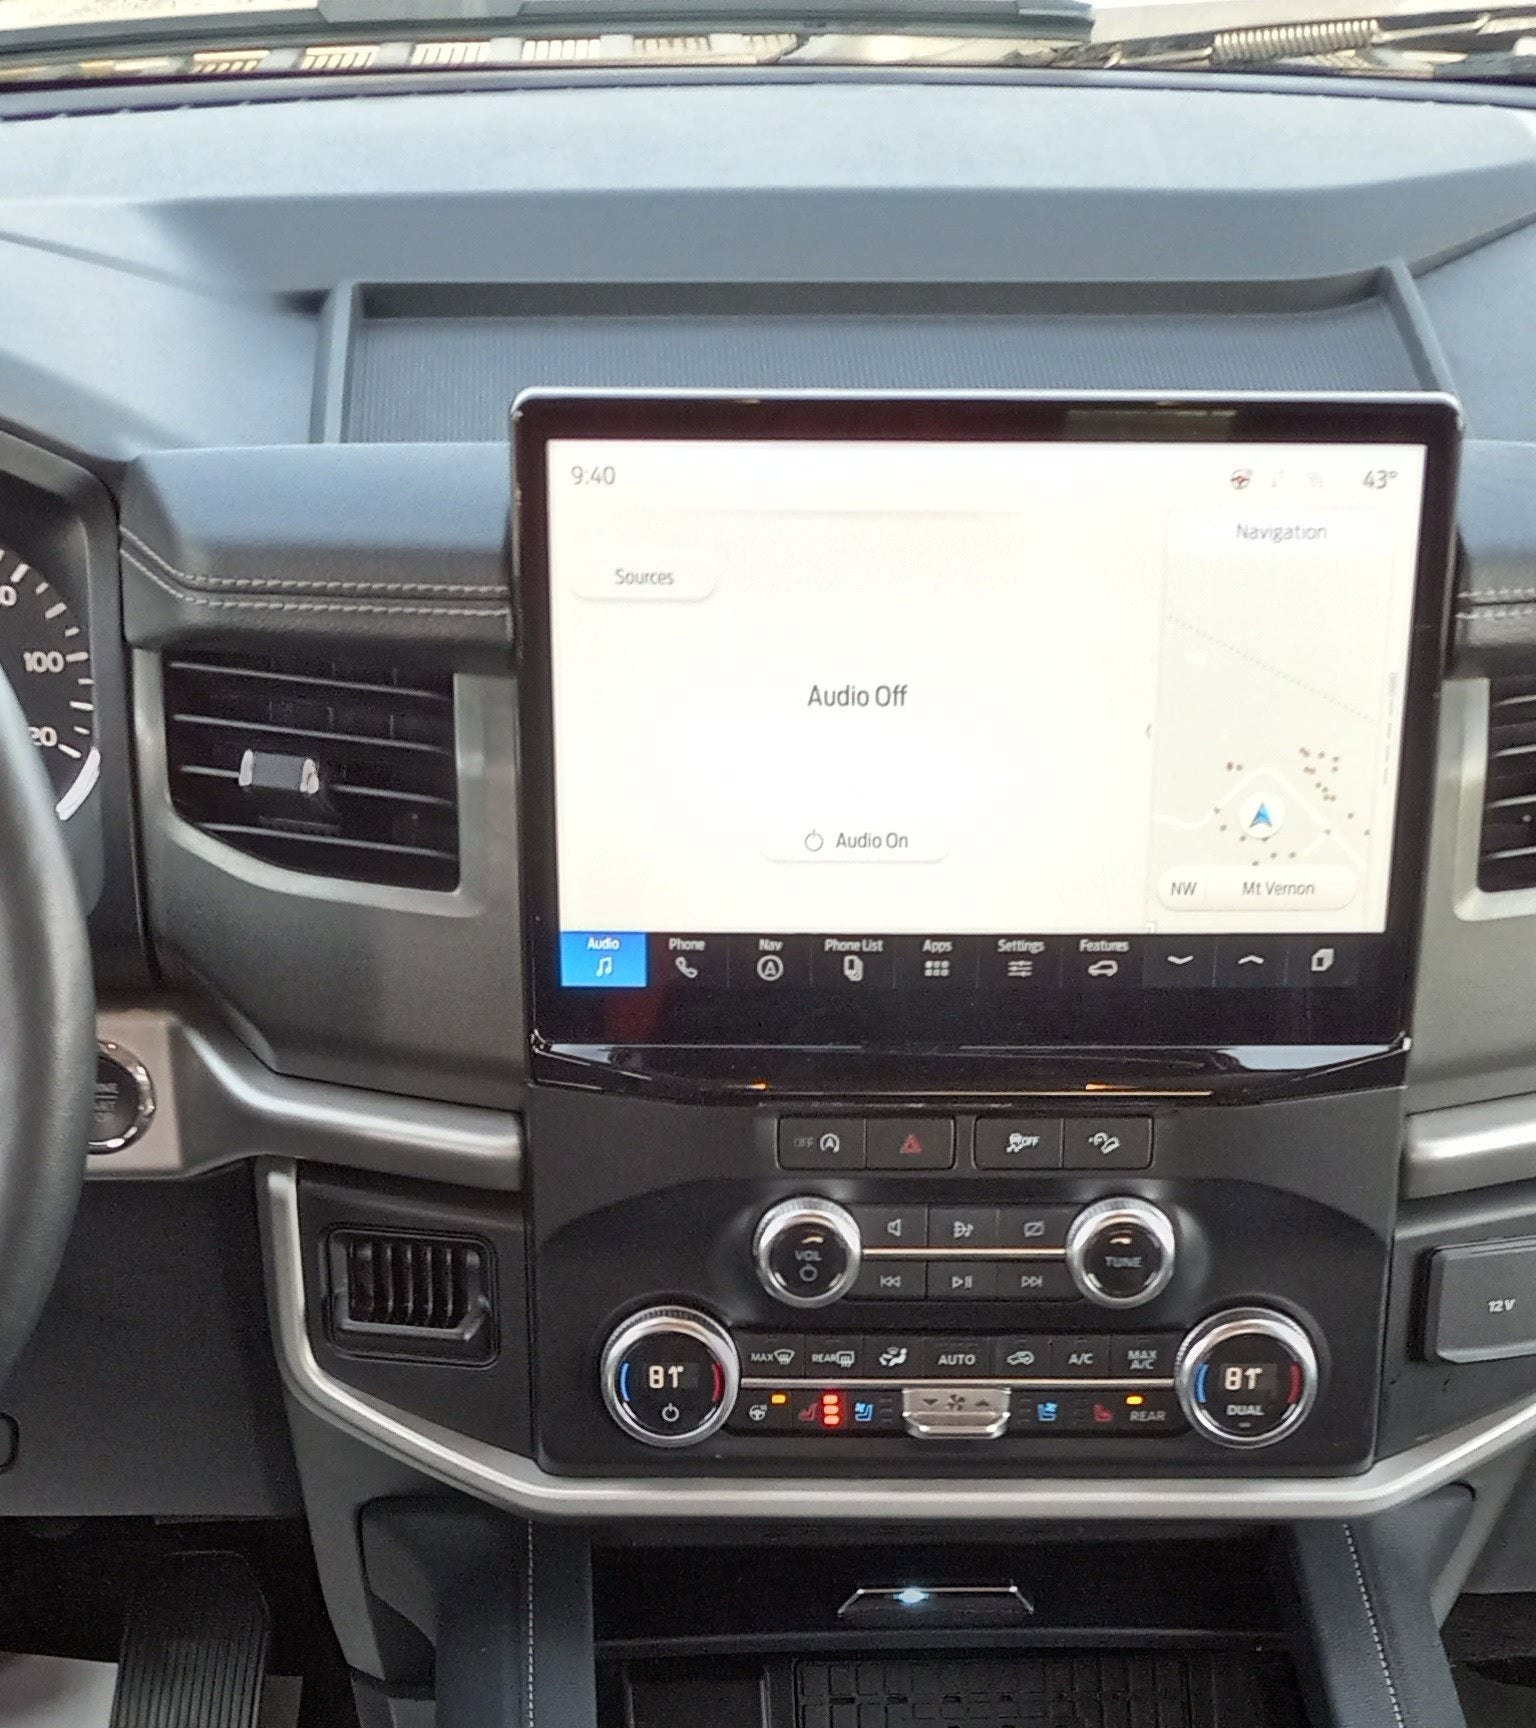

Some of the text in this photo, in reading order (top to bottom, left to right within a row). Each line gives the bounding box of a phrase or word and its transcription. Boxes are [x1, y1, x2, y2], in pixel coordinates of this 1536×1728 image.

[571, 465, 617, 486] 9:40
[1361, 469, 1399, 489] 43°
[1235, 523, 1328, 544] Navigation
[614, 567, 675, 586] Sources
[23, 651, 65, 674] 100
[807, 684, 908, 708] Audio Off
[835, 832, 910, 849] Audio On
[1170, 881, 1198, 897] NW
[1242, 881, 1316, 897] Mt Vernon
[586, 936, 621, 951] Audio
[668, 937, 706, 951] Phone
[758, 938, 783, 952] Nav
[824, 938, 884, 952] Phone List
[922, 939, 953, 954] Apps
[997, 938, 1046, 955] Settings
[1078, 938, 1130, 953] Features
[794, 1249, 822, 1262] VOL
[1104, 1255, 1143, 1269] TUNE
[750, 1352, 774, 1363] MAX
[811, 1352, 838, 1364] REAR
[937, 1352, 977, 1366] AUTO
[1068, 1351, 1094, 1366] A/C
[1127, 1349, 1158, 1361] MAX
[1129, 1359, 1155, 1371] A/C
[1129, 1410, 1166, 1423] REAR
[1226, 1404, 1264, 1417] DUAL
